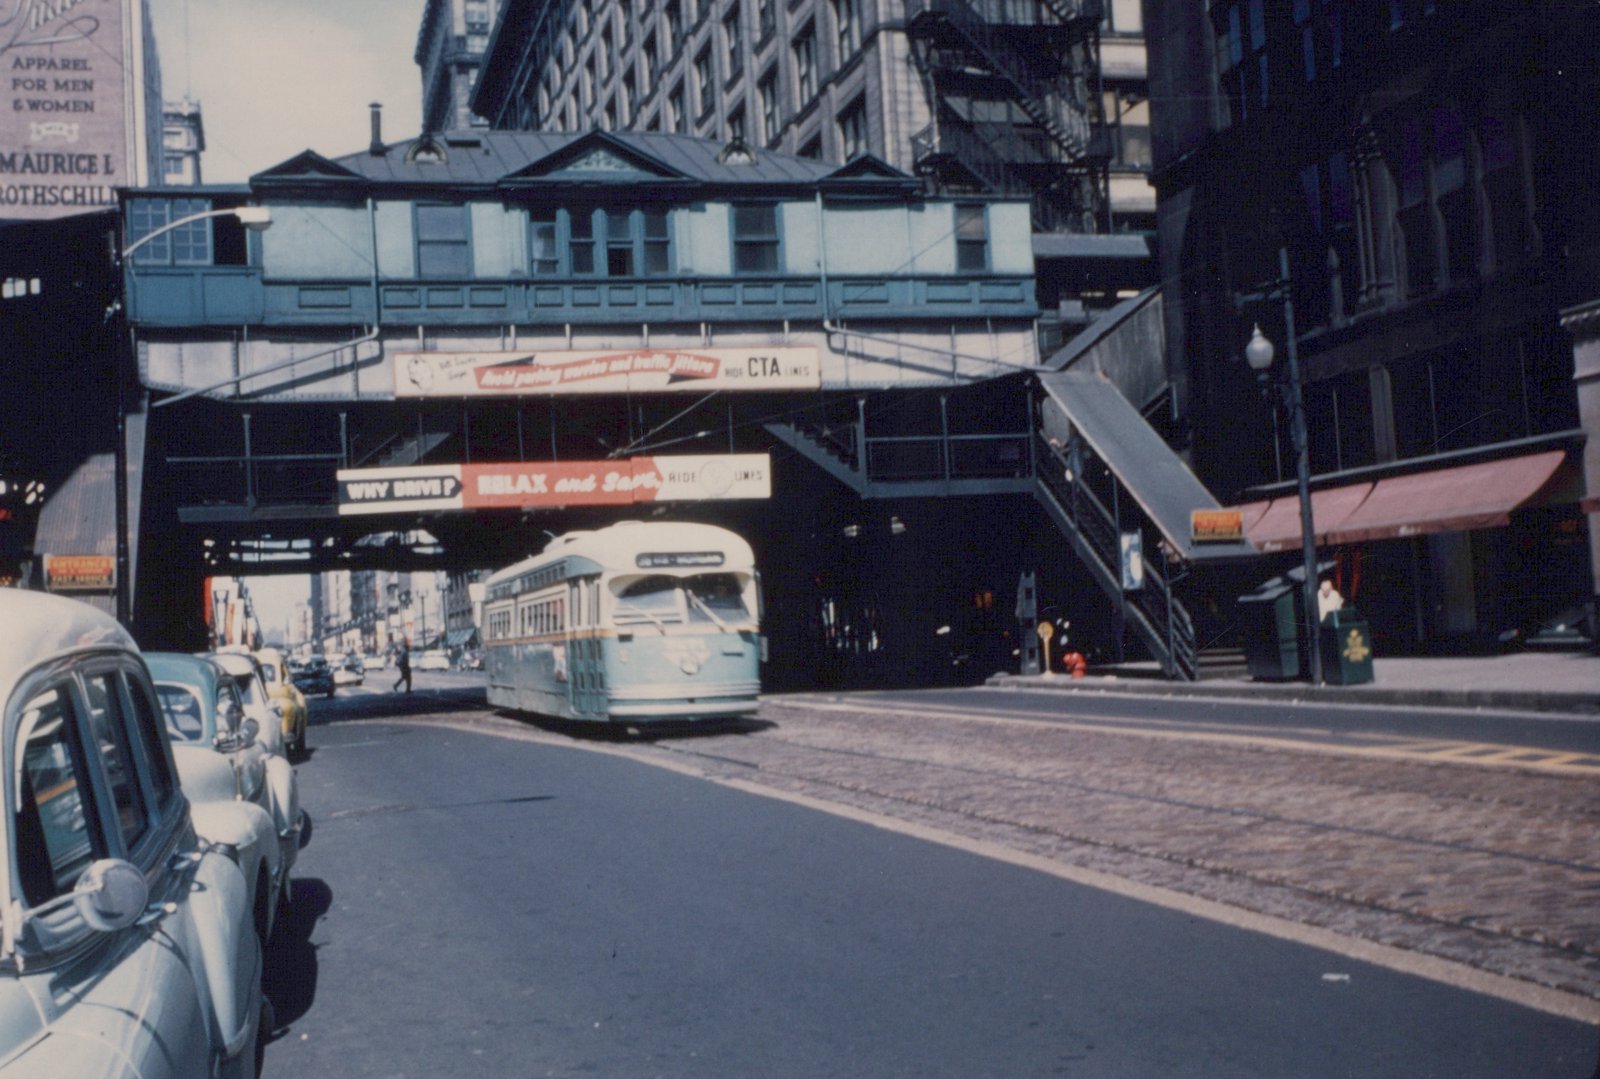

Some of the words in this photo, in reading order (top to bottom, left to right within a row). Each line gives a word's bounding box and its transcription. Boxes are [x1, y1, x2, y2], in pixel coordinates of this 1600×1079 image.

[12, 57, 93, 71] APPAREL
[12, 78, 47, 91] FOR
[54, 79, 94, 92] MEN
[13, 99, 23, 111] &
[27, 100, 95, 113] WOMEN
[0, 152, 98, 174] MAURICE
[103, 154, 115, 175] L
[748, 357, 781, 377] CTA
[346, 481, 389, 500] WHY
[477, 473, 548, 495] RELAX
[554, 473, 597, 493] and
[668, 471, 696, 483] RIDE
